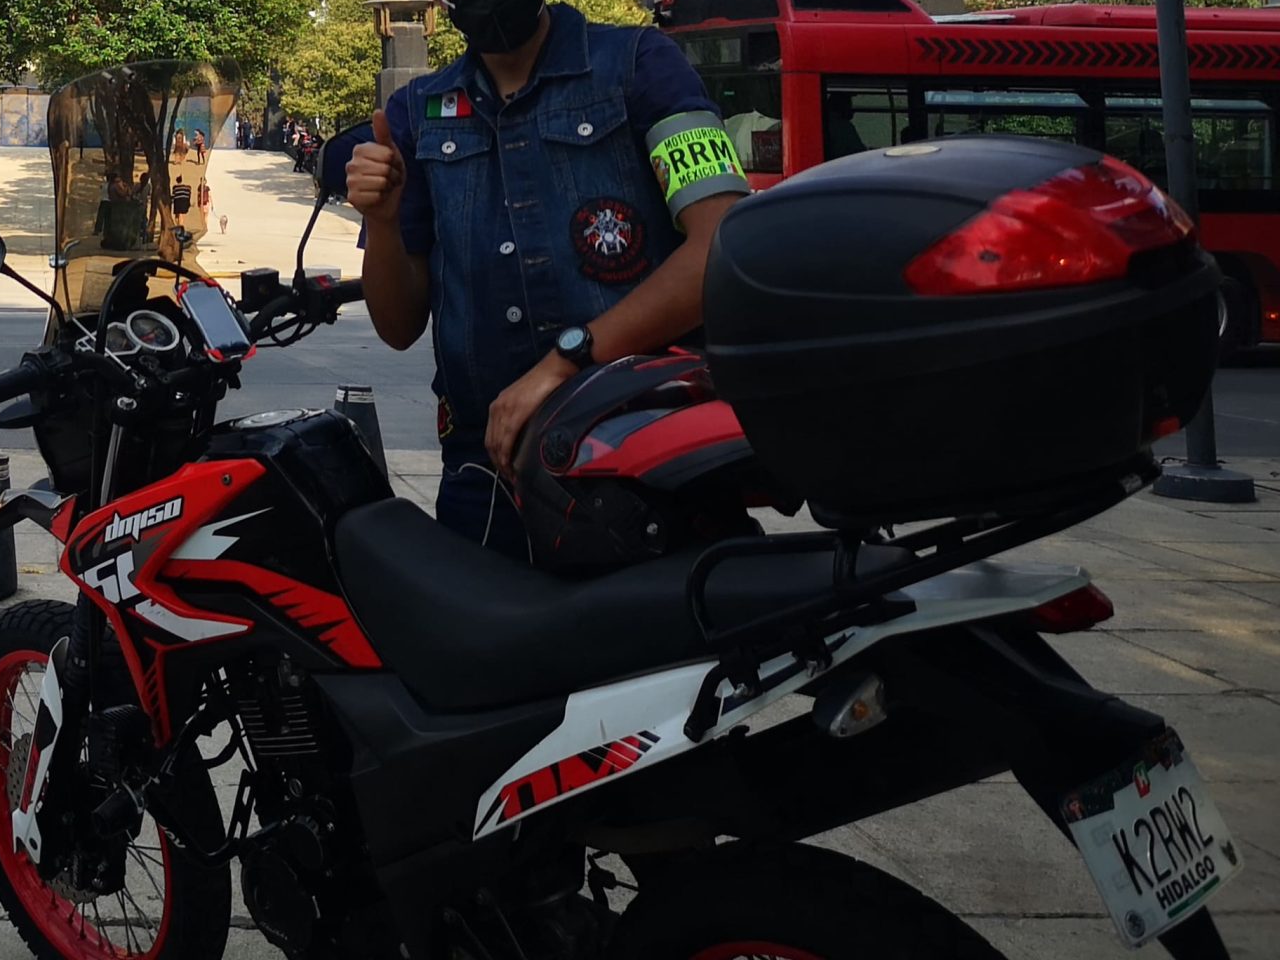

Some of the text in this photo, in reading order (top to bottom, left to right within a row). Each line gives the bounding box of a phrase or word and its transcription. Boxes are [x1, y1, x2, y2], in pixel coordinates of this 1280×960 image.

[668, 139, 734, 175] RRM
[1112, 786, 1214, 896] K2RW2
[1155, 855, 1215, 910] HIDALGO
